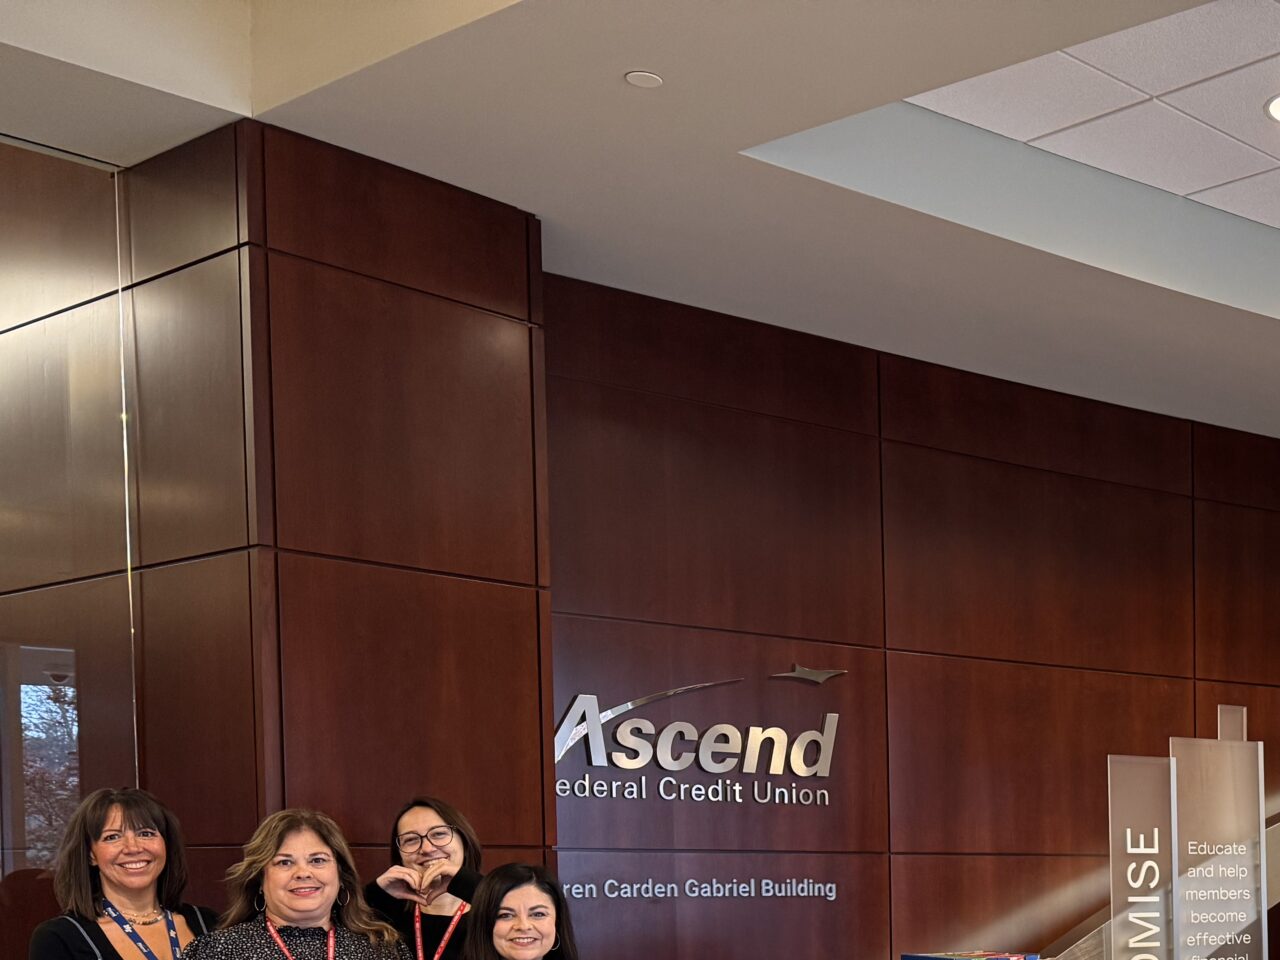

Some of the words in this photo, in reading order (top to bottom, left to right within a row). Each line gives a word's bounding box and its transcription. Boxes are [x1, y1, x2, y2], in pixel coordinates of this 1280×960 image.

[554, 694, 839, 777] Ascend
[555, 775, 646, 799] ederal
[659, 776, 743, 803] Credit
[754, 781, 829, 806] Union
[1188, 842, 1246, 855] Educate
[1187, 865, 1214, 878] and
[1219, 864, 1248, 880] help
[604, 879, 678, 898] Carden
[685, 879, 755, 898] Gabriel
[761, 880, 837, 900] Building
[1186, 887, 1250, 901] members
[1190, 910, 1247, 923] become
[1186, 931, 1251, 947] effective
